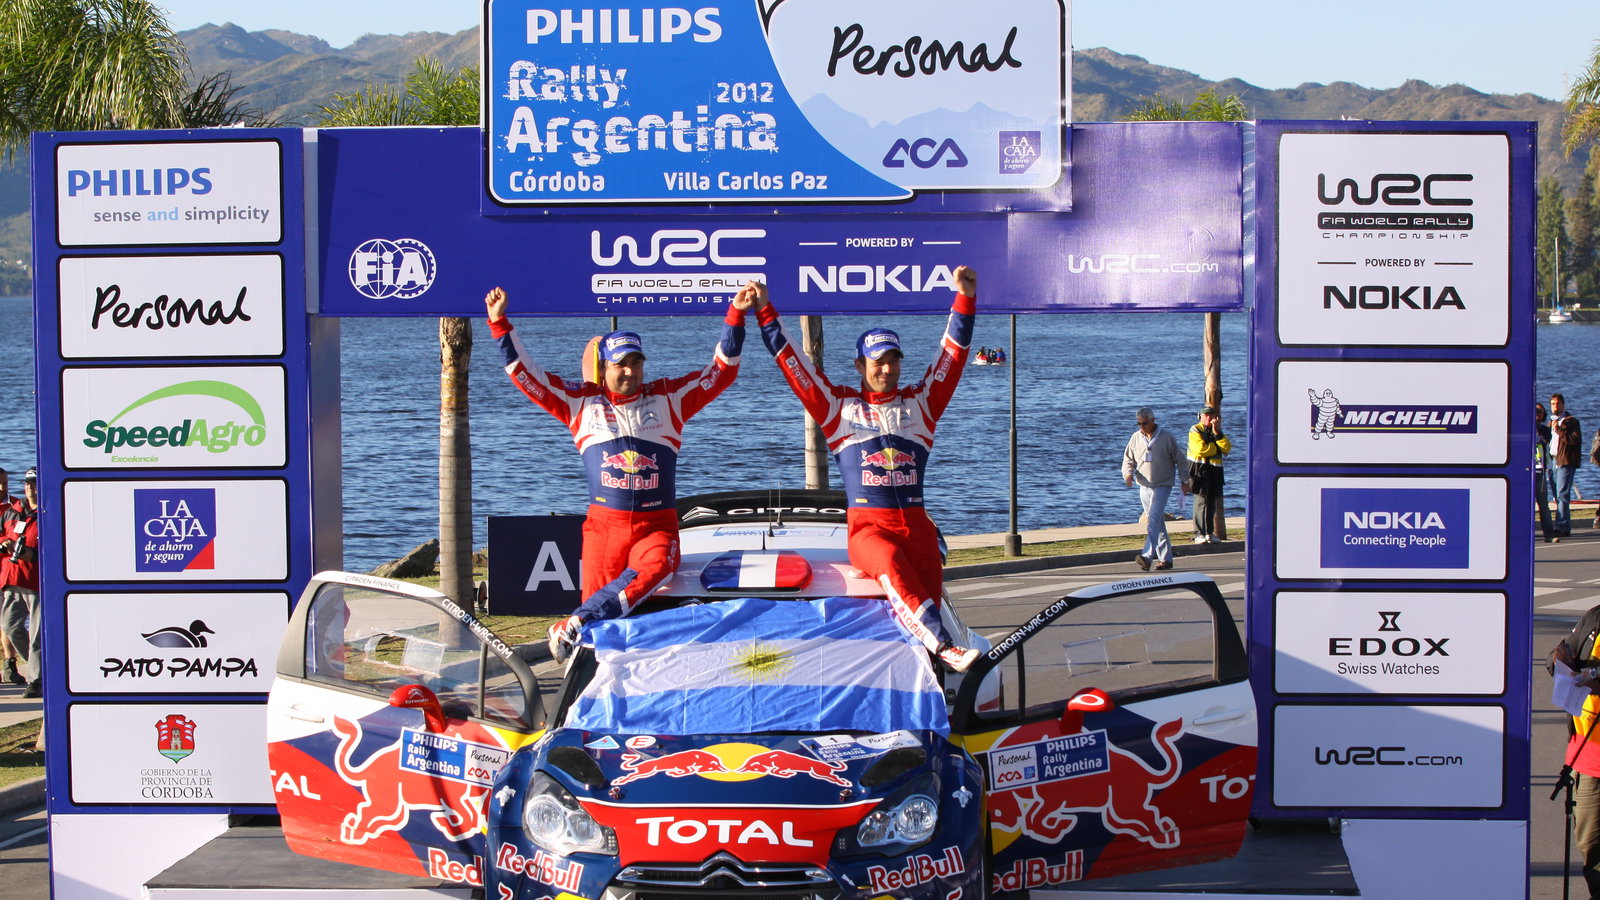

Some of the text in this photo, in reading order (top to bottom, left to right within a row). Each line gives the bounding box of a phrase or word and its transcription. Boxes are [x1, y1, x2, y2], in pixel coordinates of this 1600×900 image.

[526, 7, 723, 44] PHILIPS
[827, 23, 1022, 77] Personal
[506, 60, 628, 108] Rally
[716, 82, 774, 103] 2012
[506, 105, 777, 167] Argentina
[1012, 136, 1029, 146] LA
[882, 137, 968, 169] ACA
[1003, 146, 1037, 159] CAJA
[67, 167, 213, 197] PHILIPS
[509, 168, 828, 192] Córdoba Villa Carlos Paz
[1317, 173, 1474, 206] WRC
[94, 206, 270, 224] sense and simplicity
[1322, 217, 1469, 227] FIA WORLD RALLY
[845, 237, 914, 248] POWERED BY
[1322, 232, 1469, 240] CHAMPIONSHIP
[591, 229, 766, 267] WRC
[1365, 258, 1426, 268] POWERED BY
[597, 279, 760, 288] FIA WORLD RALL
[799, 264, 959, 293] NOKIA
[1323, 285, 1466, 310] NOKIA
[91, 284, 251, 330] Personal
[1343, 410, 1473, 426] MICHELIN
[83, 418, 266, 453] SpeedAgro
[111, 455, 158, 463] Excelencia
[601, 471, 659, 490] Red Bull
[862, 469, 917, 486] Red Bull
[159, 499, 194, 518] LA
[727, 507, 847, 515] CITRO
[1344, 511, 1446, 529] NOKIA
[144, 518, 208, 542] CAJA
[144, 540, 193, 551] de ahorro
[1343, 534, 1446, 548] Connecting People
[145, 553, 184, 564] y seguro
[524, 541, 582, 592] A
[372, 579, 400, 590] FINANCE
[1142, 577, 1173, 587] FINANCE
[1328, 637, 1450, 657] EDOX
[100, 658, 258, 678] PATO PAMPA
[1337, 662, 1440, 675] Swiss Watches
[412, 733, 458, 752] PHILIPS
[632, 737, 649, 747] E
[868, 732, 902, 744] Personal
[1046, 735, 1096, 753] PHILIPS
[407, 744, 430, 758] Rally
[471, 749, 501, 764] Personal
[998, 751, 1032, 766] Personal
[1042, 753, 1068, 765] Rally
[140, 769, 185, 777] GOBIERNO
[407, 754, 460, 776] Argentina
[467, 767, 490, 780] ACA
[1044, 757, 1102, 778] Argentina
[141, 777, 213, 786] PROVINCIA DE
[997, 771, 1022, 783] ACA
[1200, 774, 1256, 803] TO
[636, 816, 814, 847] TOTAL
[428, 847, 484, 886] Red
[496, 842, 584, 893] Red Bull
[867, 845, 965, 895] Red Bull
[1025, 849, 1083, 888] Bull
